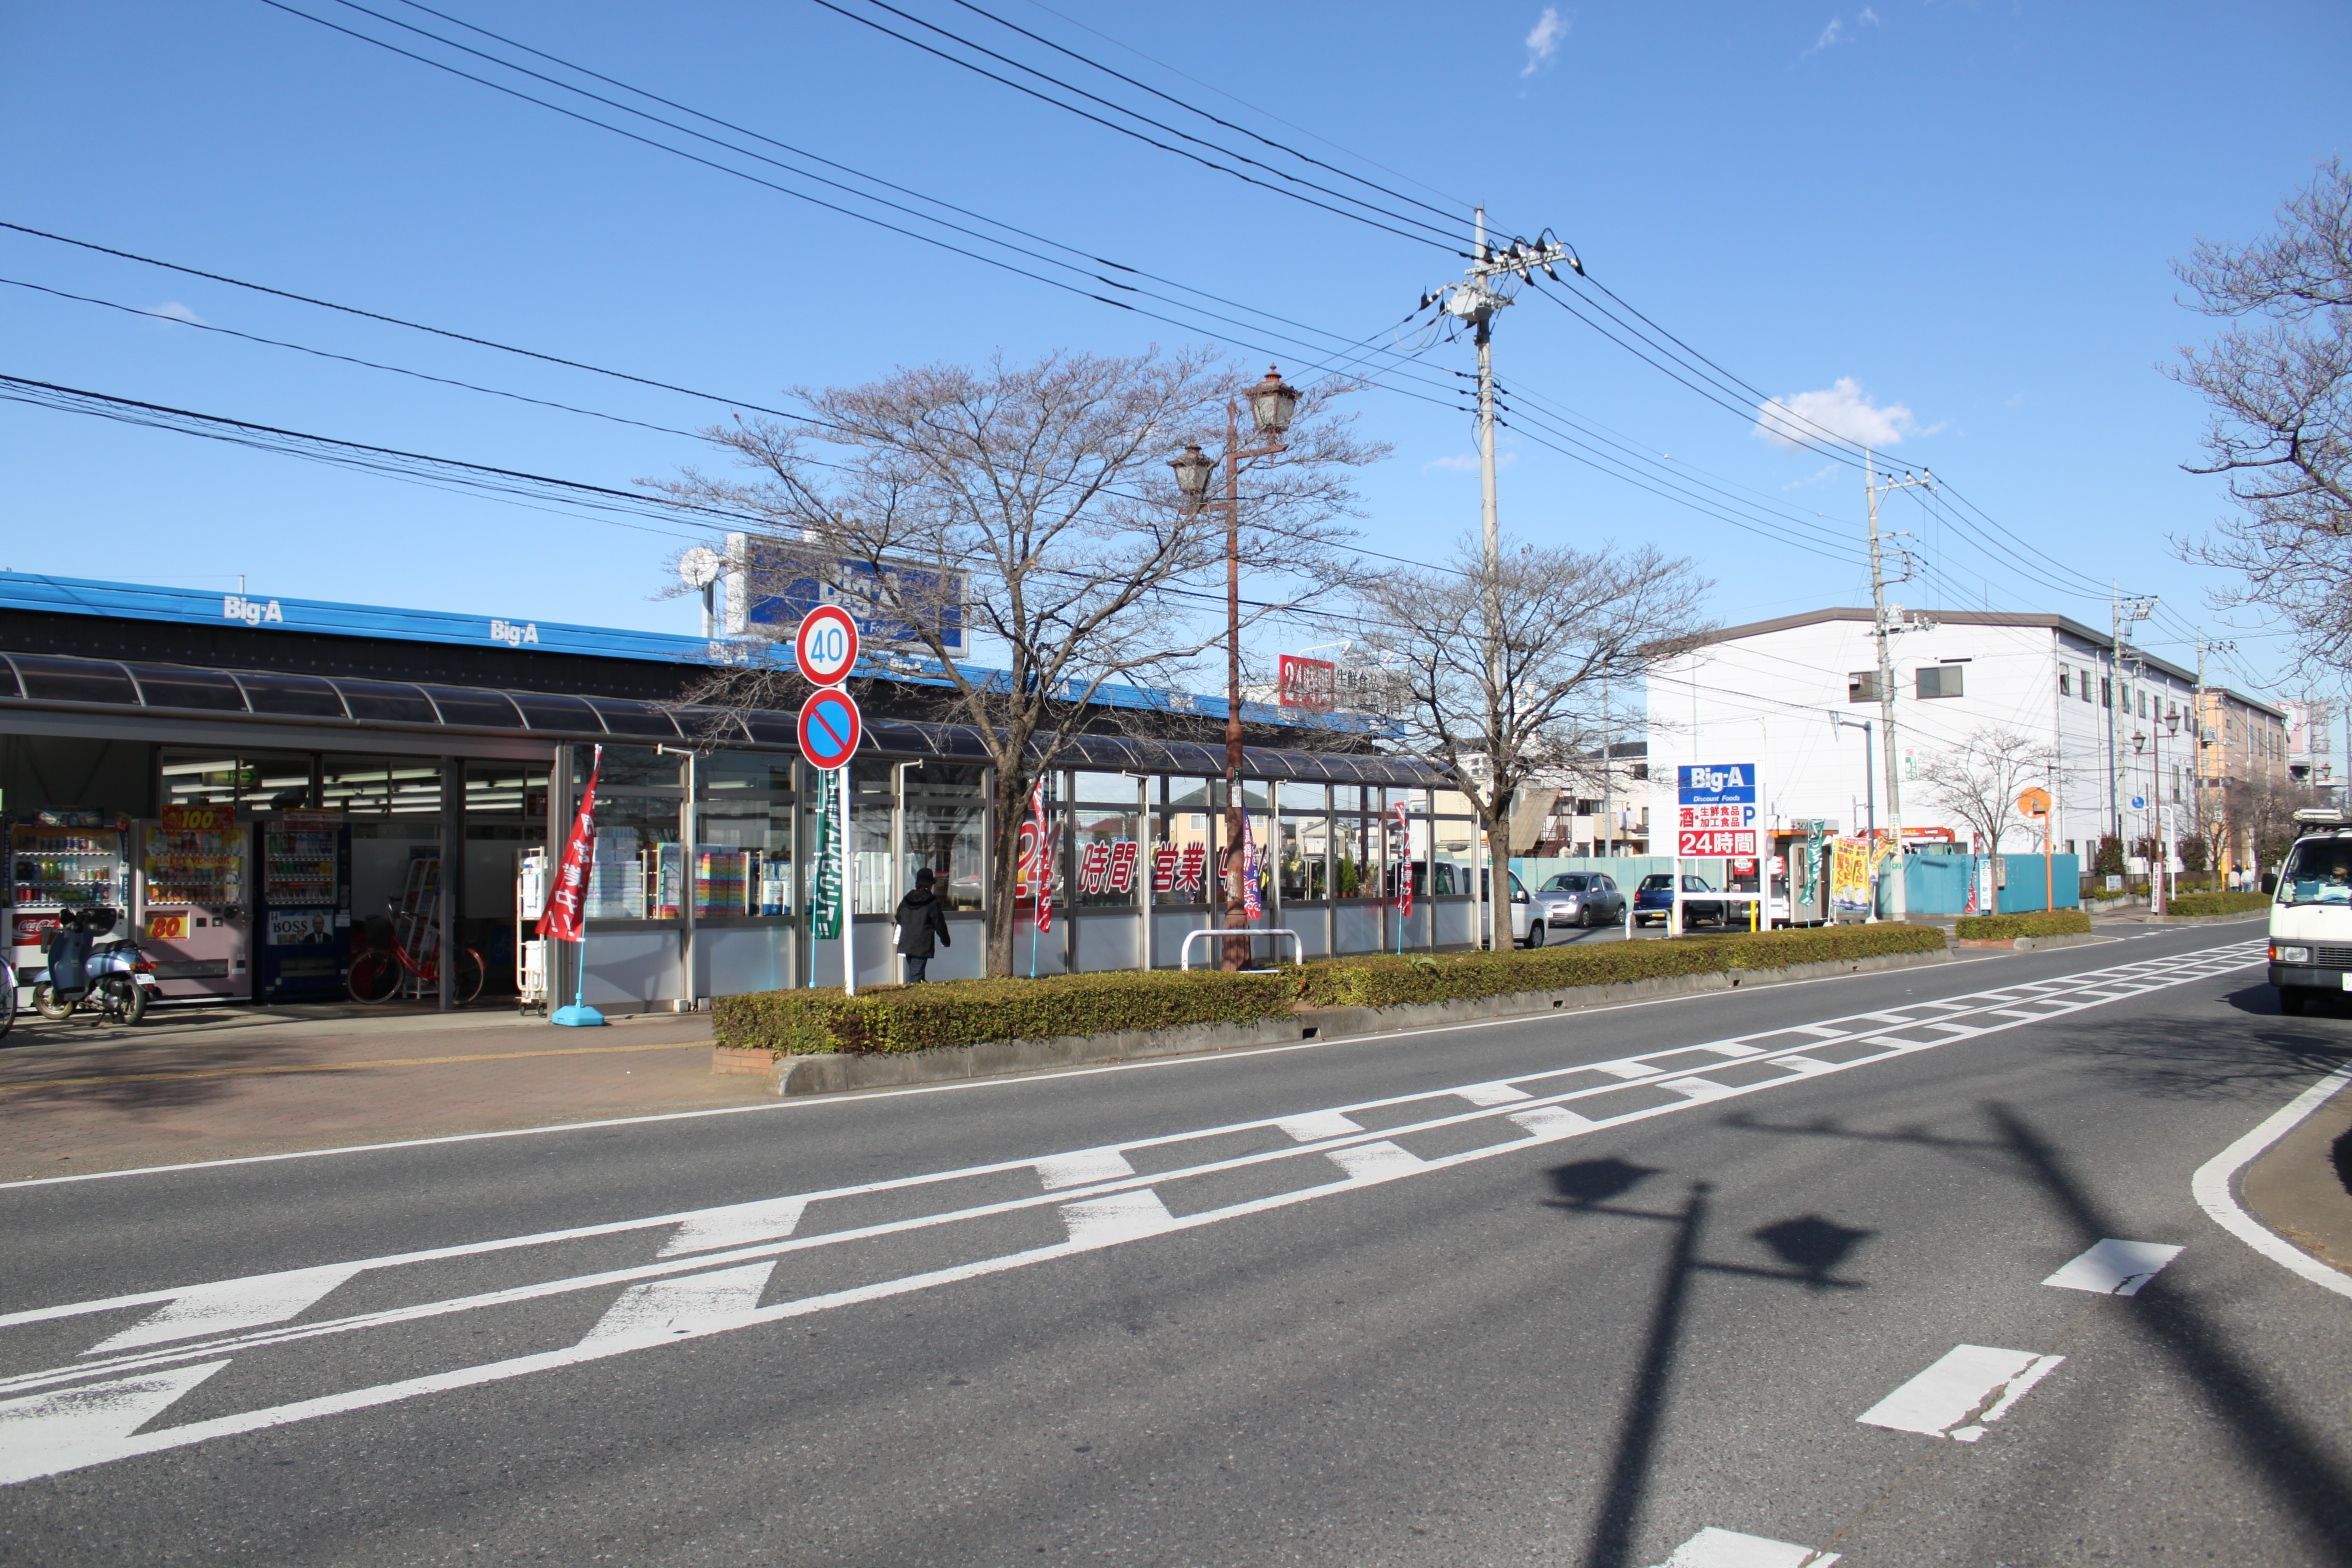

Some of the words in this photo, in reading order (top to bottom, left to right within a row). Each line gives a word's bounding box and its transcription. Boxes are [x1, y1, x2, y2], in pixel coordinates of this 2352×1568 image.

[224, 596, 283, 625] Big-A
[490, 620, 539, 646] Big-A
[811, 628, 843, 663] 40
[1691, 767, 1744, 792] Big-A
[1743, 806, 1756, 827] P
[1681, 832, 1755, 854] 24時間
[152, 917, 181, 937] 80
